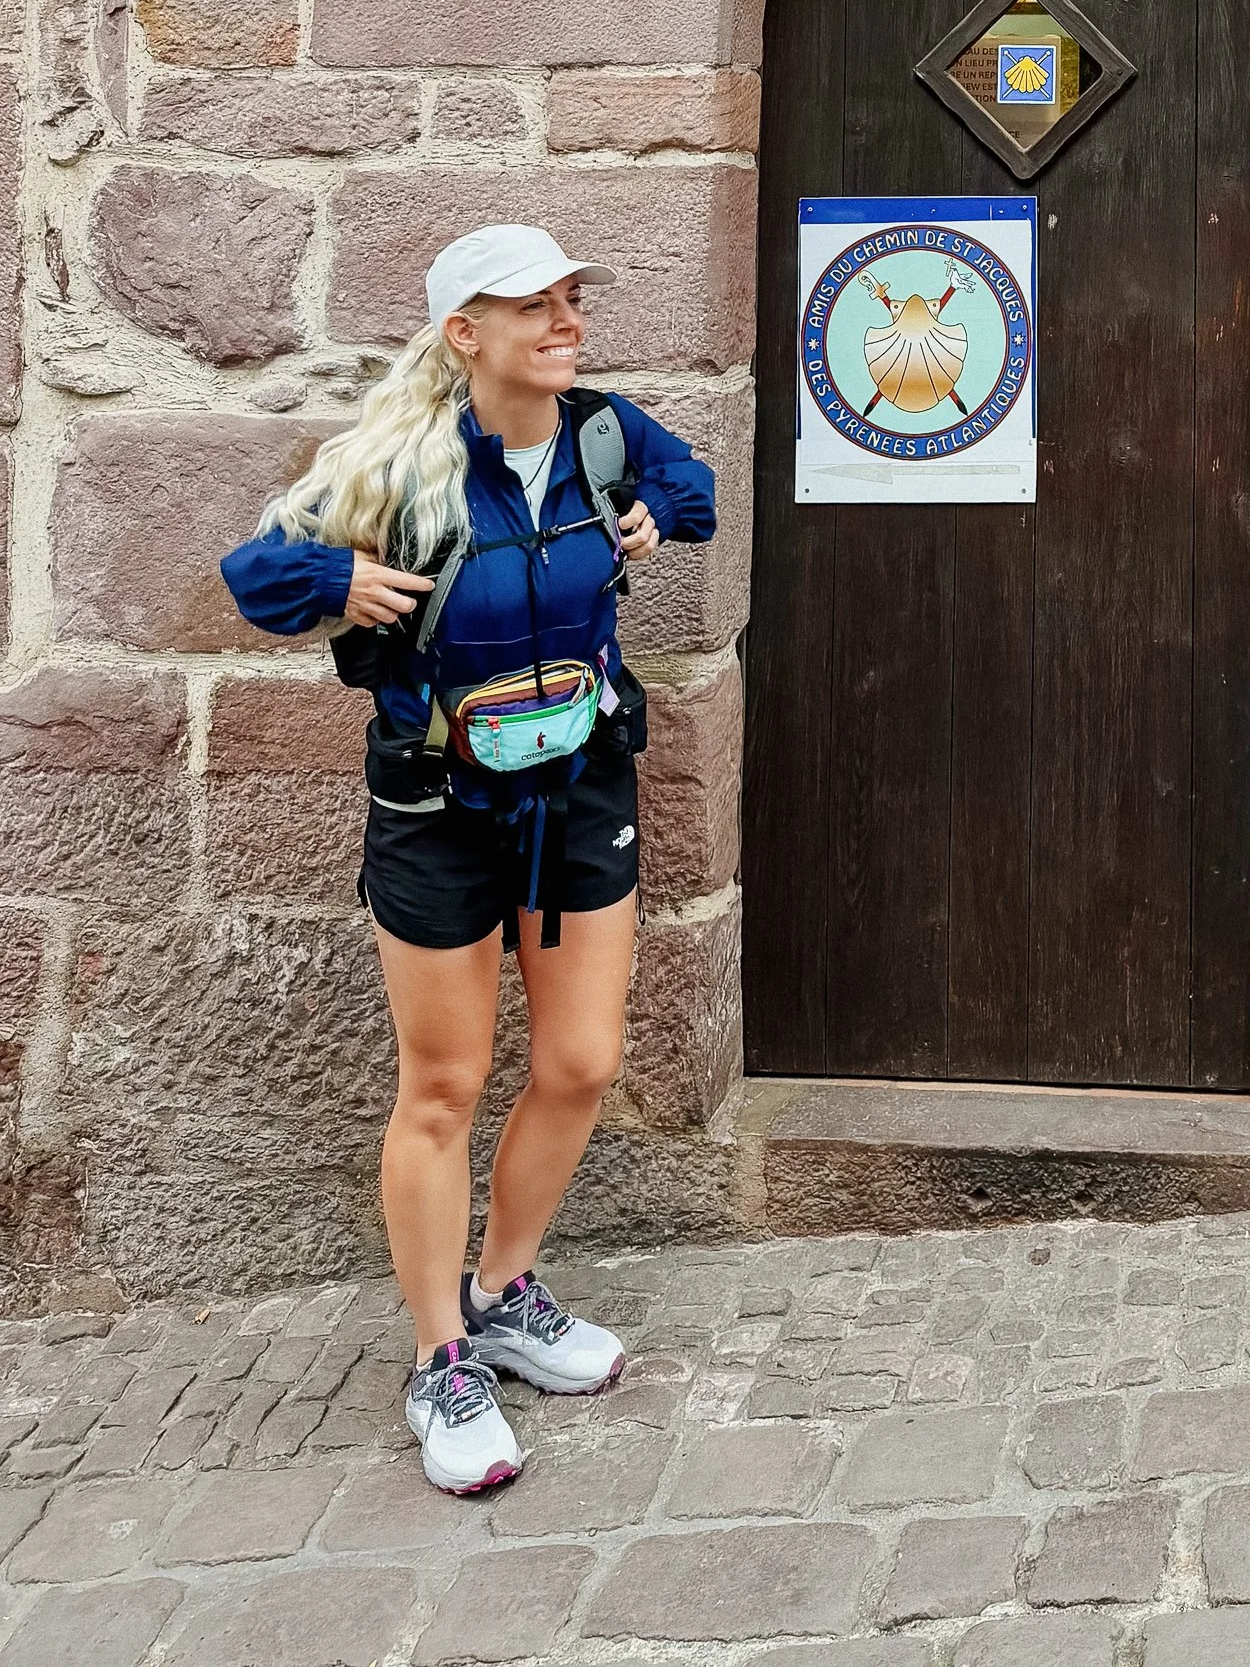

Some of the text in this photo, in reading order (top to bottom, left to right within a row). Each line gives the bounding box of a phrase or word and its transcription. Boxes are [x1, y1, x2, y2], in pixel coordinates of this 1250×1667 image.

[965, 47, 980, 55] AU
[965, 59, 985, 67] LIEU
[963, 71, 976, 79] UN
[808, 230, 1024, 328] AMIS DU CHEMIN DE ST JACQUES
[808, 356, 1025, 456] DES PYRENEES ATLANTIQUES
